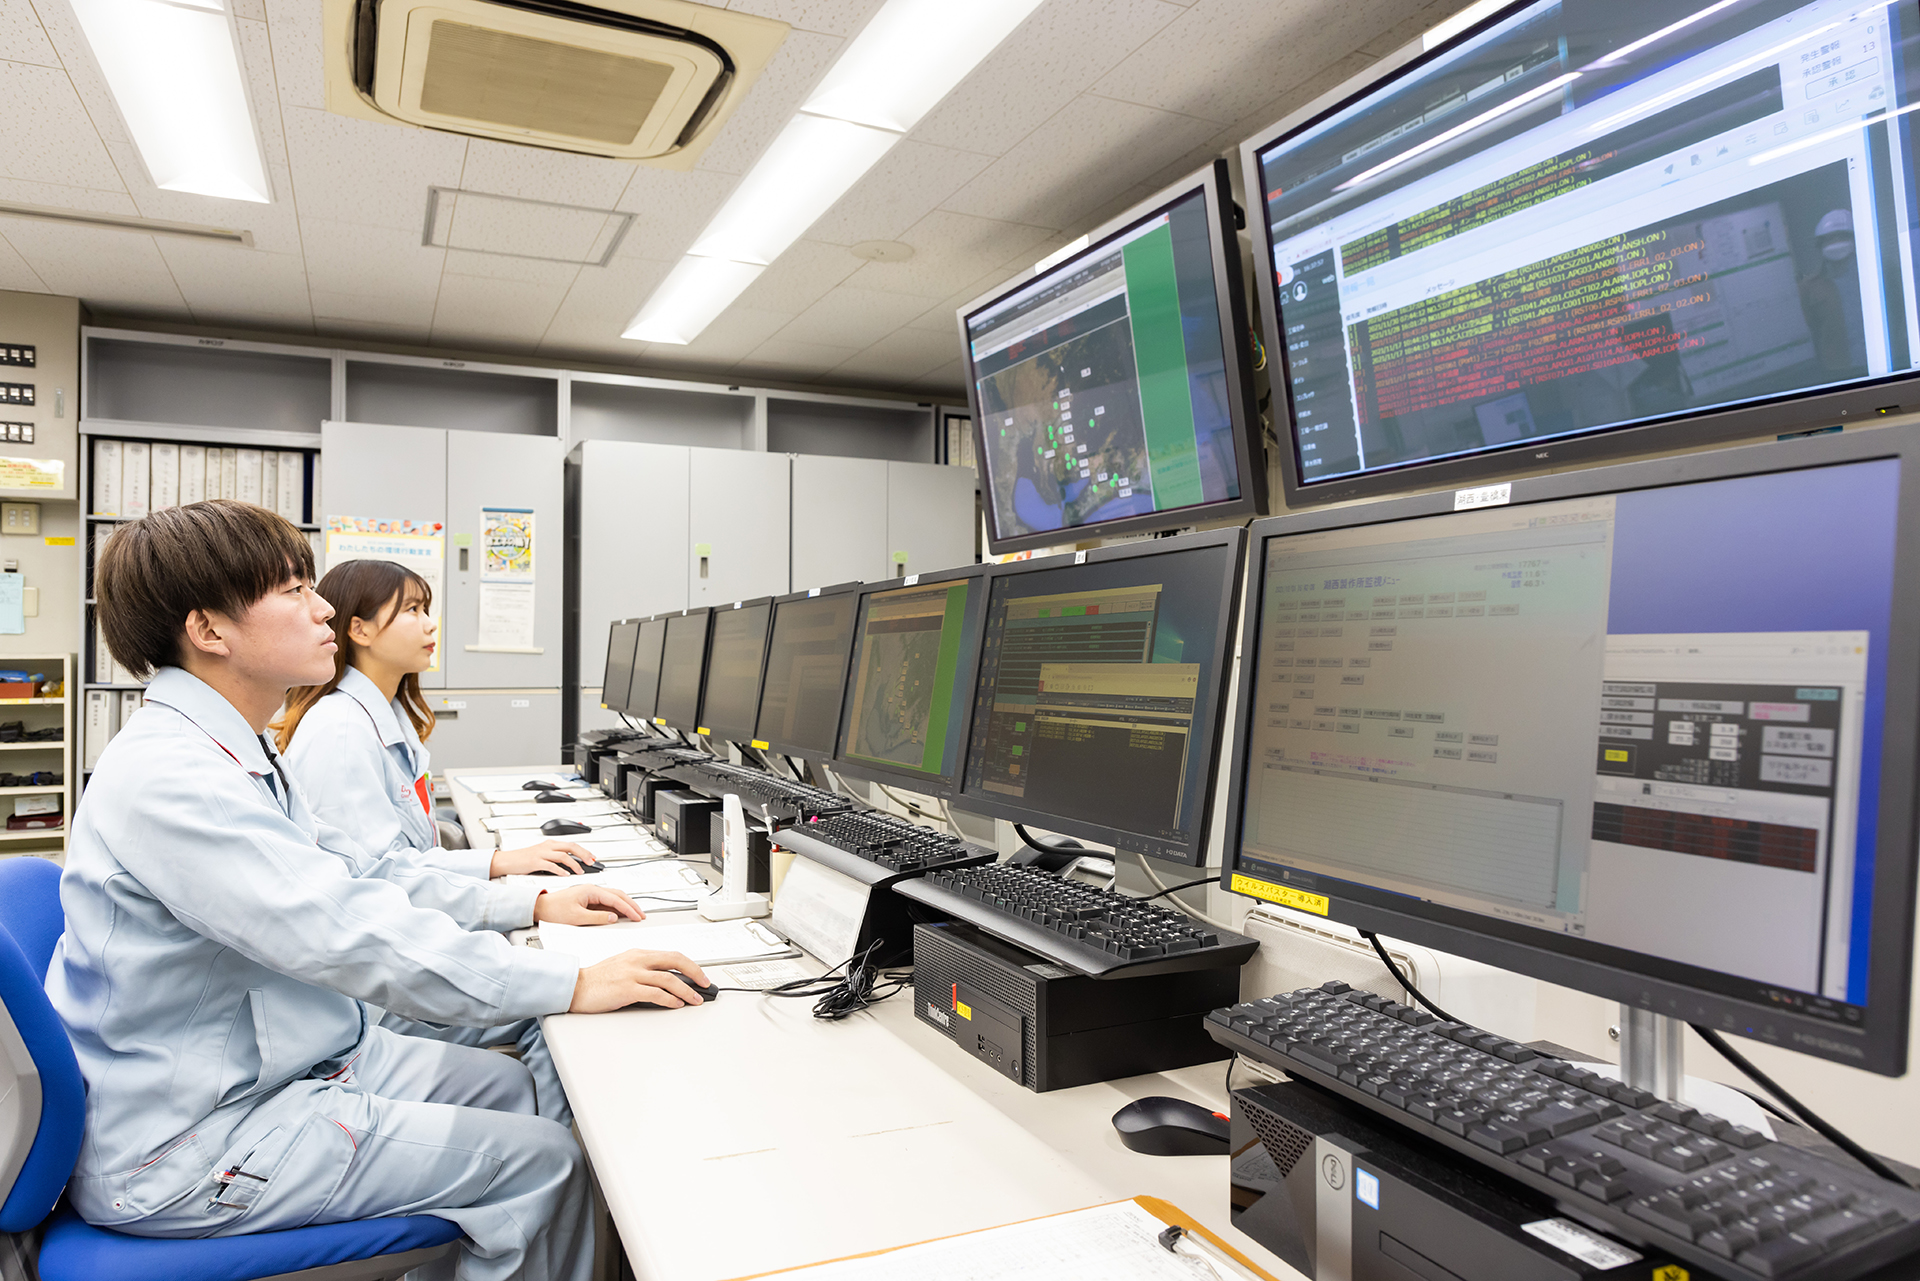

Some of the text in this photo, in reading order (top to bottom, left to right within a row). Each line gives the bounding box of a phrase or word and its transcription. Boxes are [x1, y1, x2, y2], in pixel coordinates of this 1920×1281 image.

[1862, 41, 1875, 53] 13
[1425, 278, 1455, 295] メッセージ
[1535, 451, 1549, 459] NEC
[1518, 560, 1541, 568] 17767
